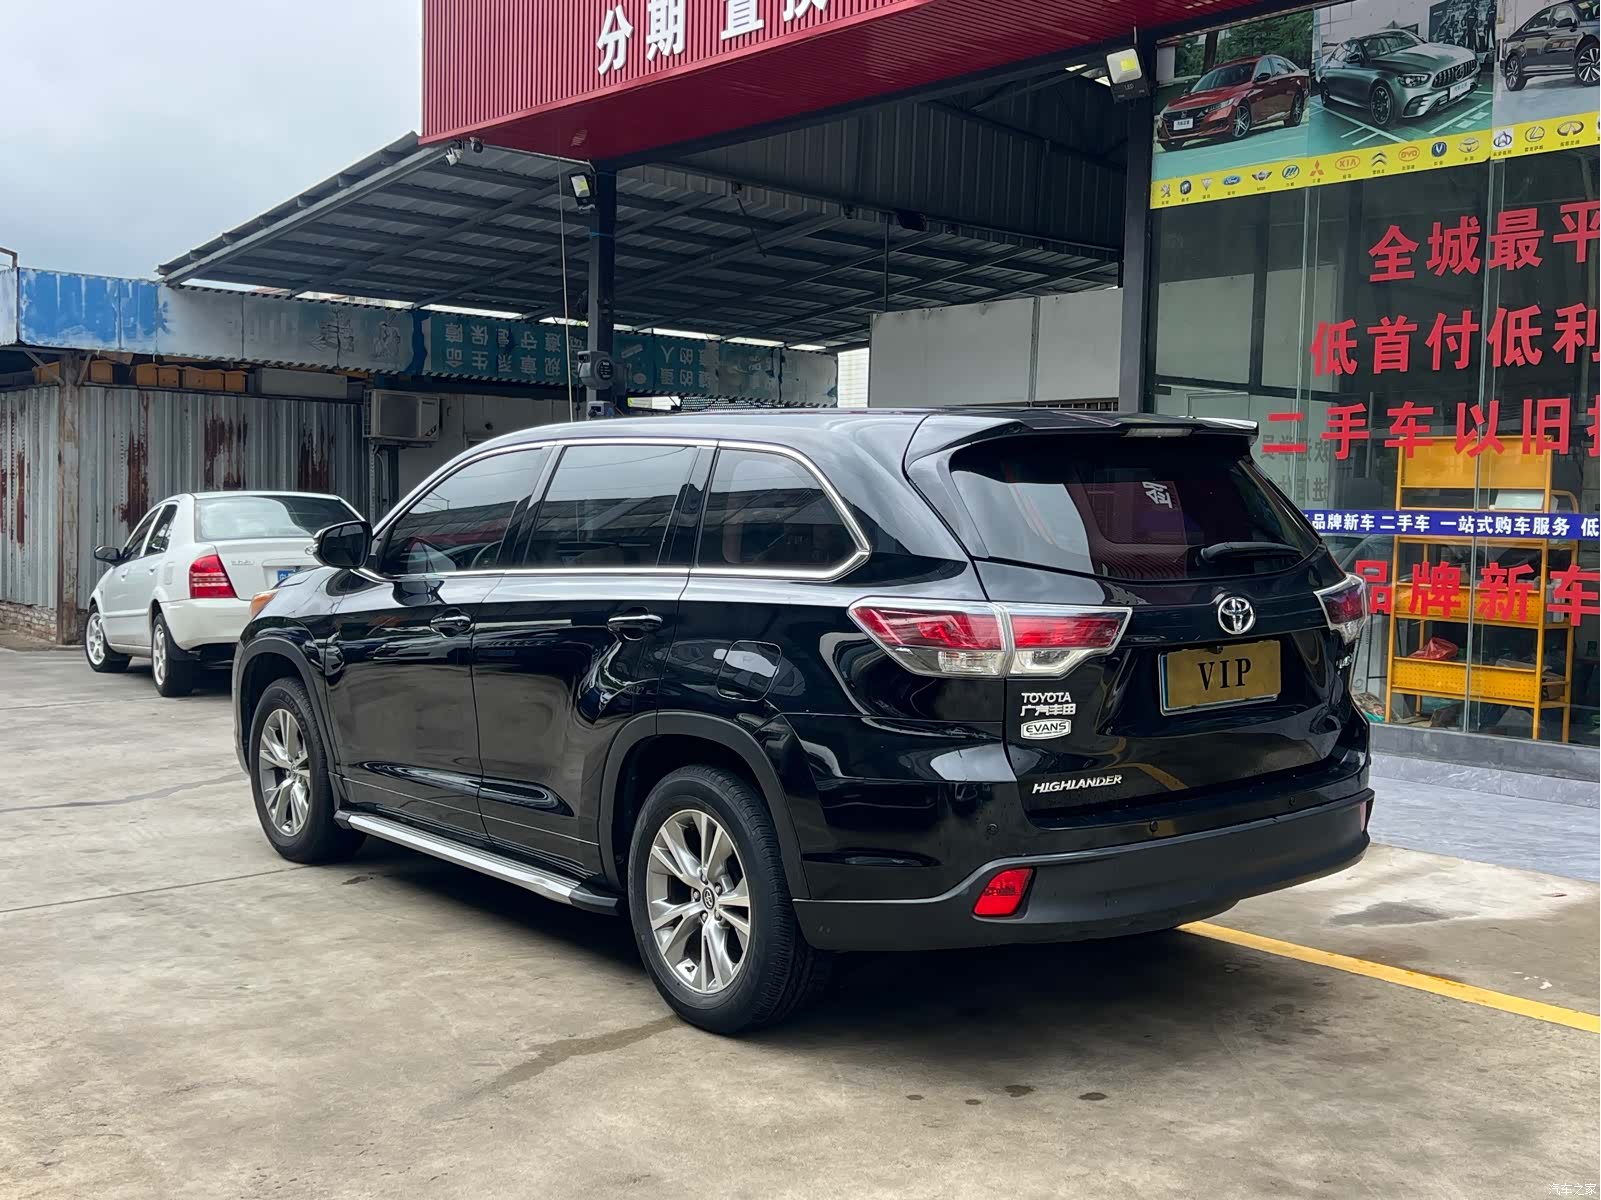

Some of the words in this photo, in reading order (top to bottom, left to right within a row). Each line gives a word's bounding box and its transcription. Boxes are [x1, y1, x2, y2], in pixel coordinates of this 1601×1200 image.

[596, 0, 686, 76] 分期
[1338, 158, 1357, 168] KIA
[1368, 200, 1600, 282] 全城最平
[1304, 512, 1375, 532] 品牌新车
[1379, 514, 1430, 533] 二手车
[1440, 515, 1570, 537] 一站式购车服务
[1580, 517, 1600, 537] 低
[1197, 658, 1252, 691] VIP
[1021, 692, 1072, 703] TOYOTA
[1020, 704, 1076, 716] 广汽丰田
[1026, 722, 1067, 733] EVANS
[1031, 774, 1122, 794] HIGHLANDER
